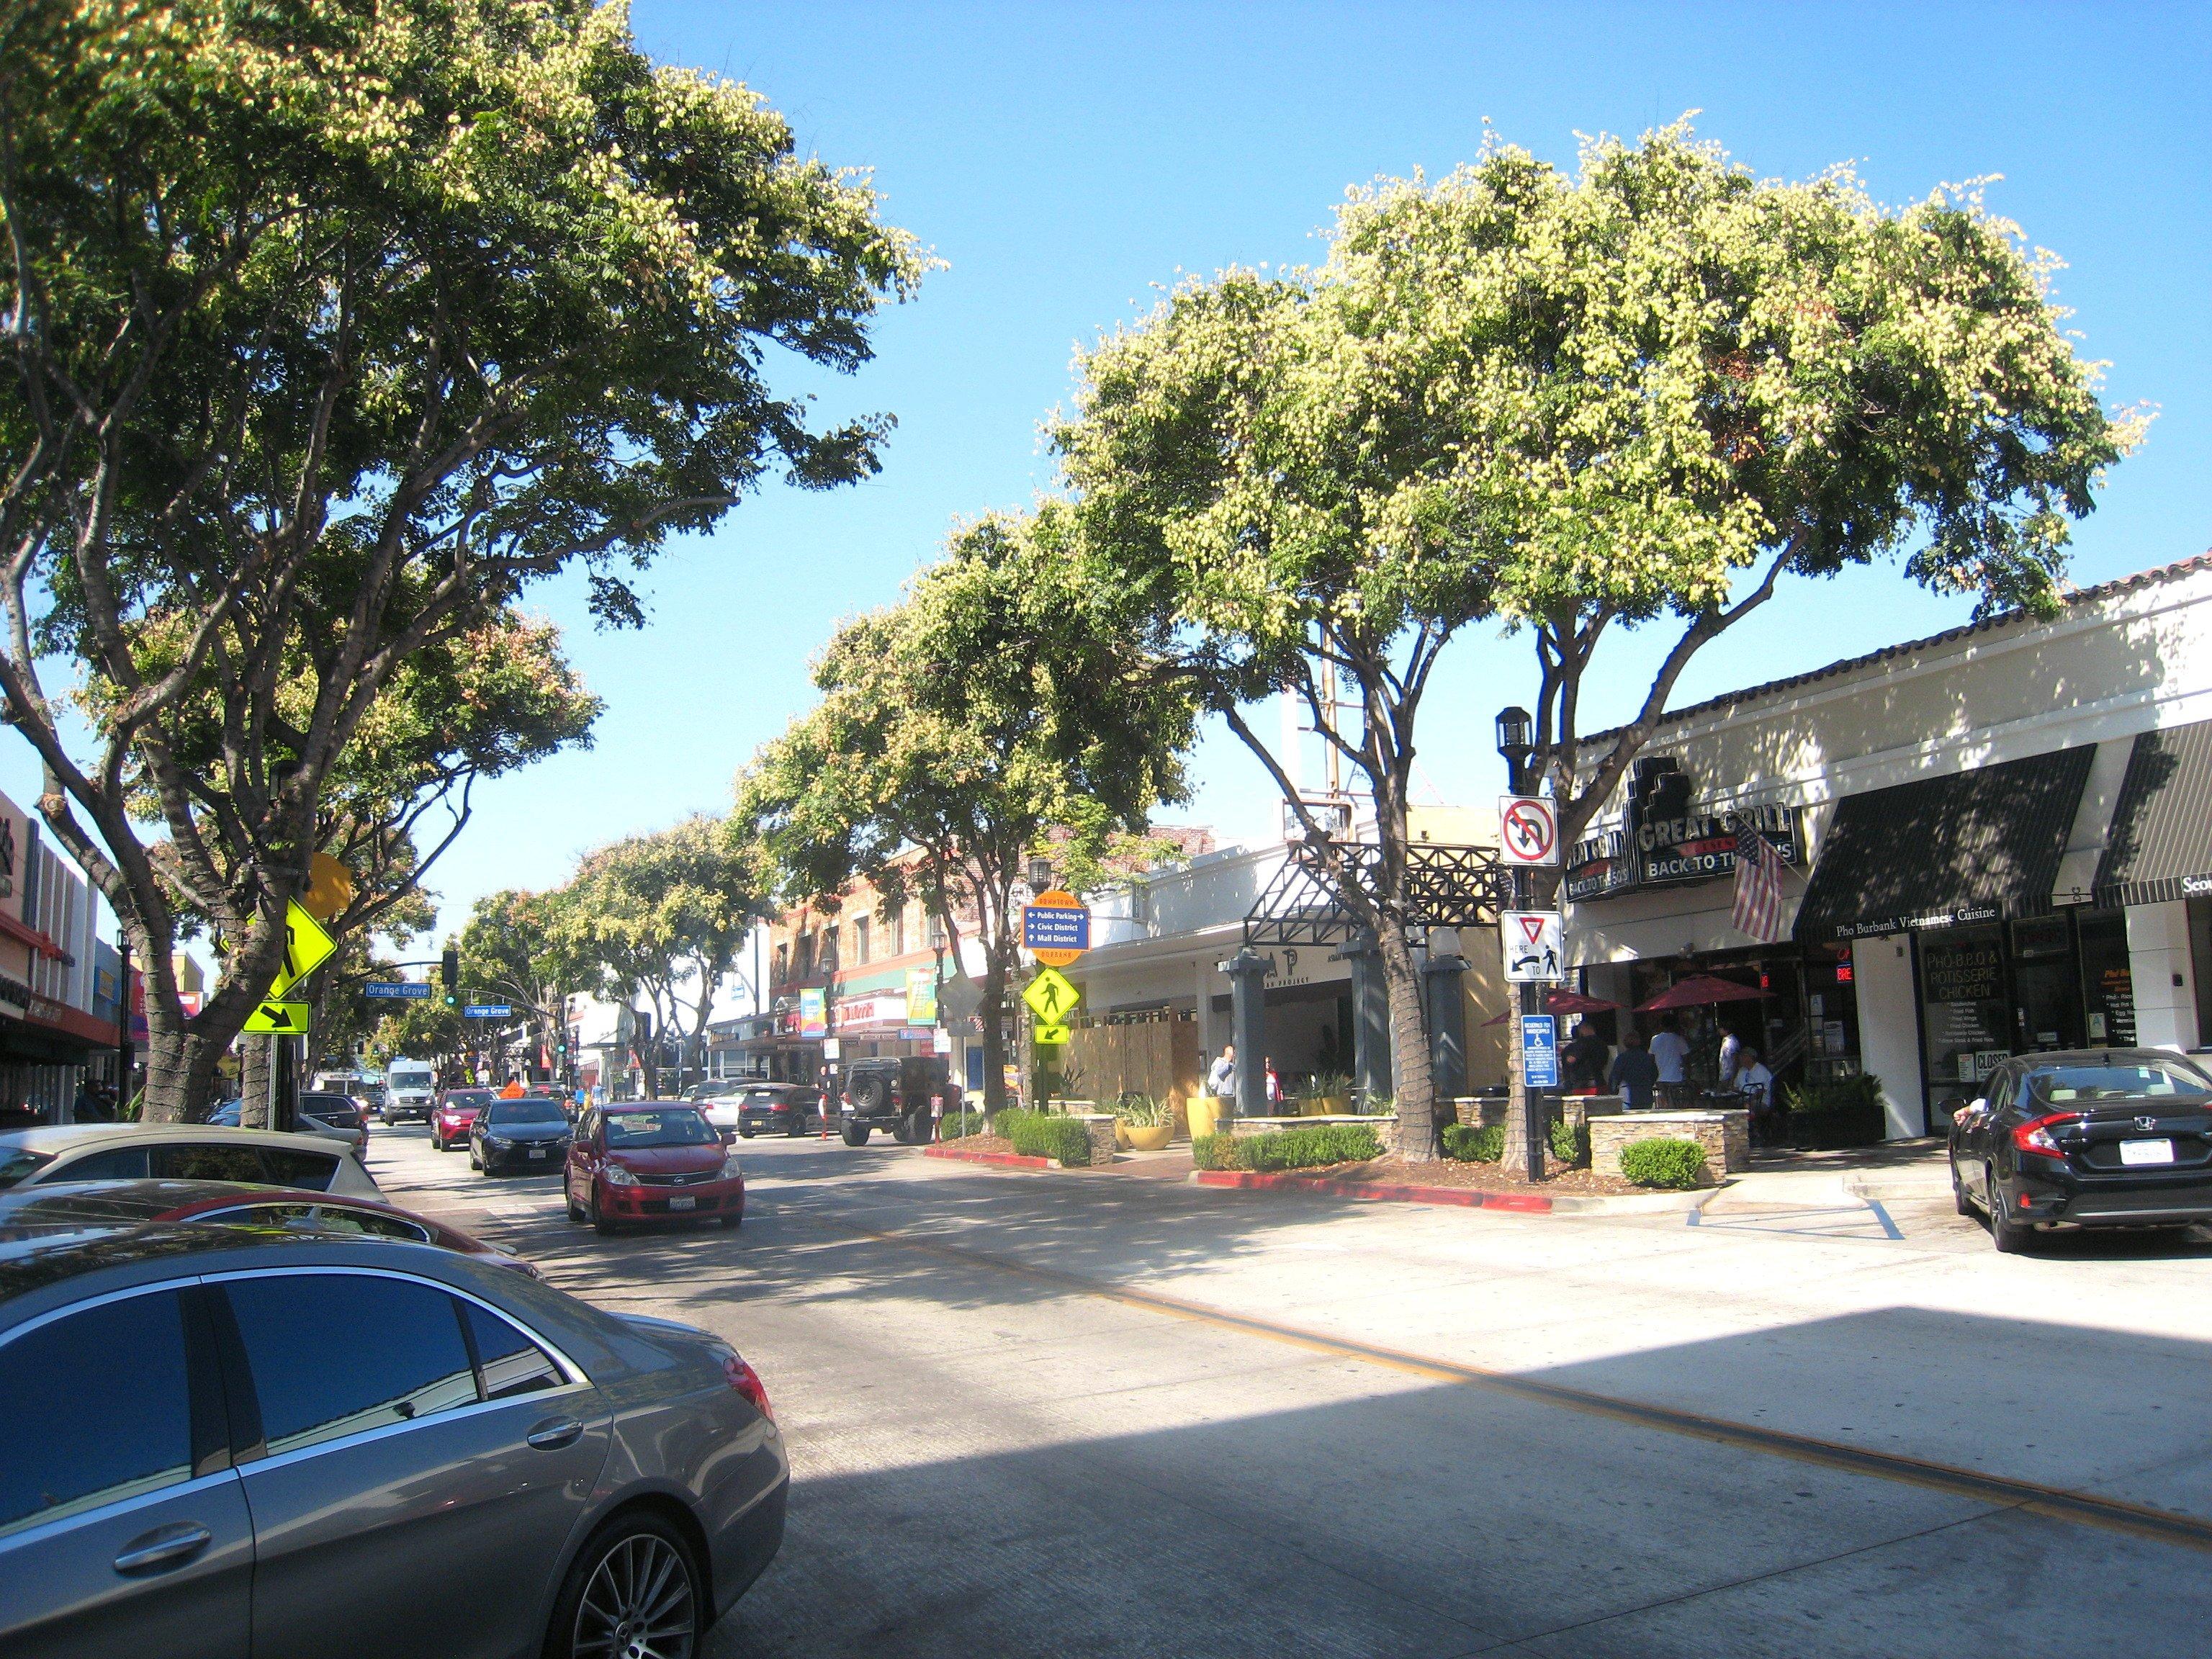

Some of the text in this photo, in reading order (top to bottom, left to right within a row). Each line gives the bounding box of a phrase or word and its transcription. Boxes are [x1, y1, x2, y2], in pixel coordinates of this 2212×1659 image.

[1638, 813, 1712, 852] GREAT
[1719, 802, 1790, 833] GRILL
[1648, 857, 1689, 878] BACK
[1692, 854, 1715, 871] TO
[1719, 850, 1737, 868] TH
[1056, 912, 1077, 922] Parking
[1836, 907, 1995, 937] Pho Burbank Vietnamese Cuisine
[1037, 922, 1053, 931] Civic
[1509, 945, 1529, 954] HERE
[1989, 950, 1997, 965] &
[1532, 966, 1541, 975] TO
[1930, 967, 1997, 985] ROTISSERIE
[368, 985, 427, 997] Orange Grove
[1939, 984, 1990, 999] CHICKEN
